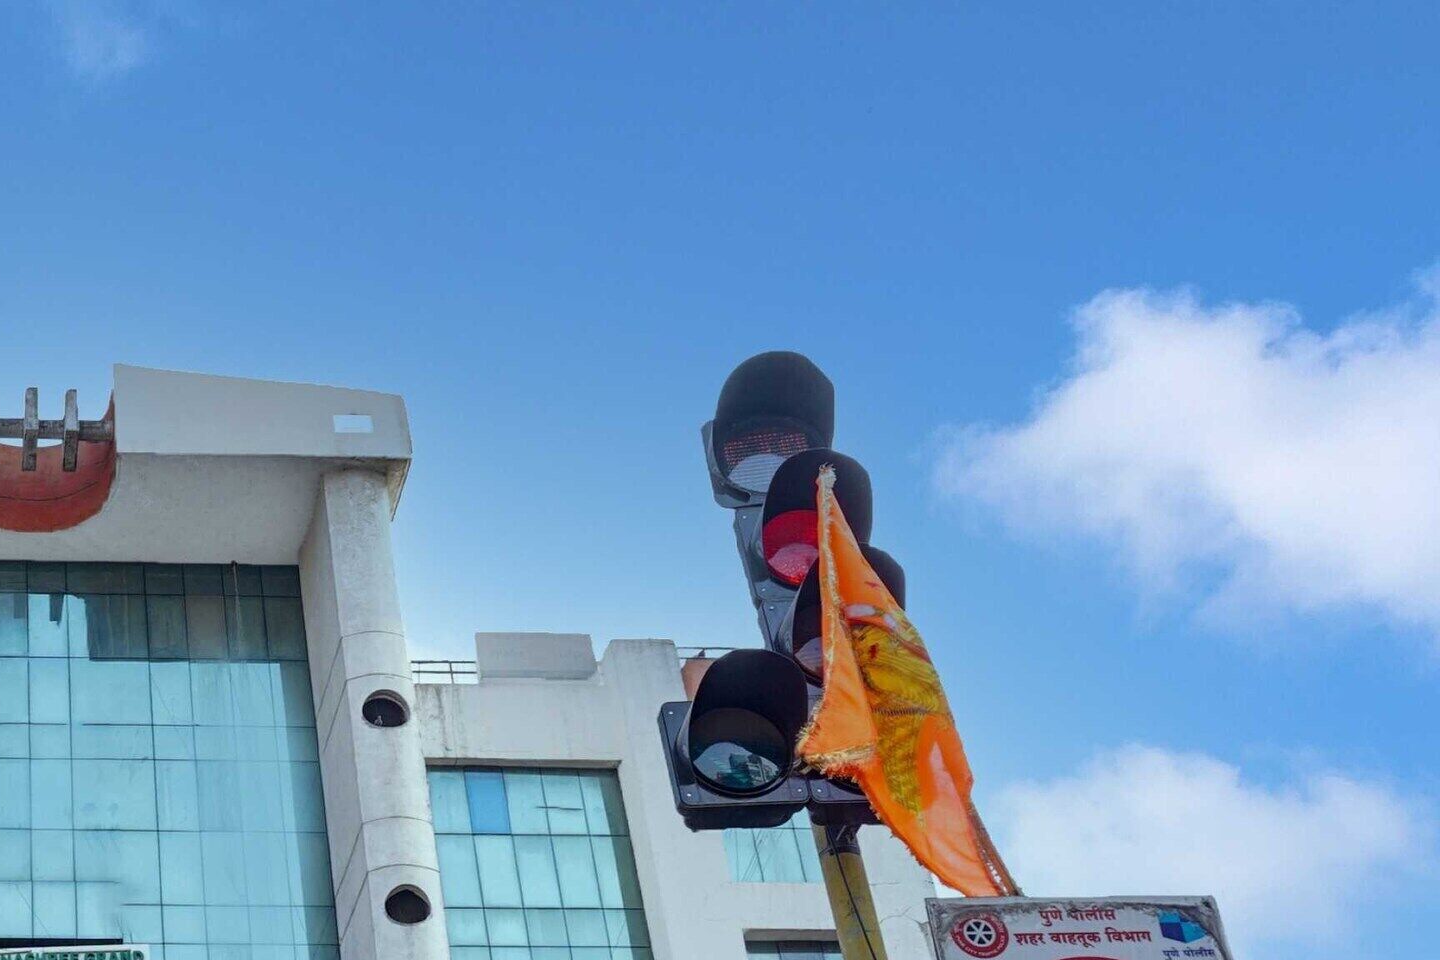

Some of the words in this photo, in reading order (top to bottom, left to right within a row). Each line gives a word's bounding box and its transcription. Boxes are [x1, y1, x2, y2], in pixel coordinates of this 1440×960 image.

[1040, 909, 1063, 926] पुणे
[1014, 933, 1045, 946] शहर
[1049, 931, 1101, 948] वाहतूक
[1105, 927, 1153, 943] विभाग
